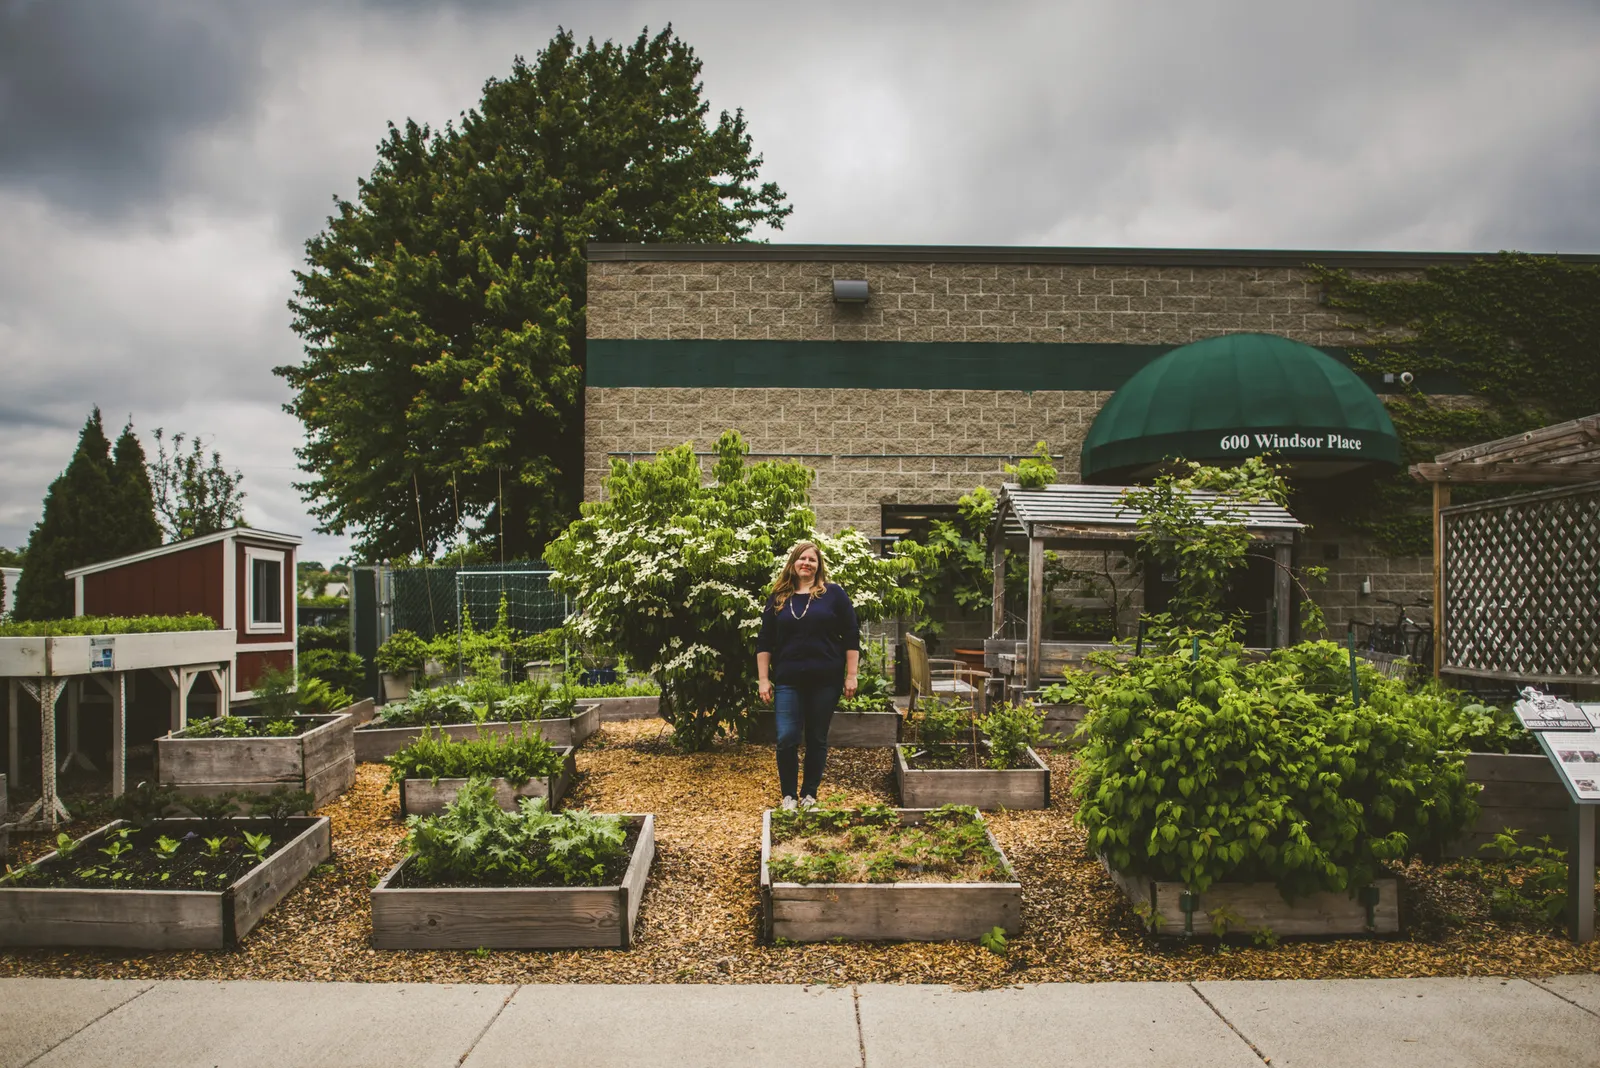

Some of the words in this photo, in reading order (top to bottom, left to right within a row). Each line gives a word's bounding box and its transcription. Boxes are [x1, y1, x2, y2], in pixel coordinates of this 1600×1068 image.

[1220, 434, 1250, 450] 600
[1254, 433, 1324, 449] Windsor
[1327, 433, 1362, 450] Place
